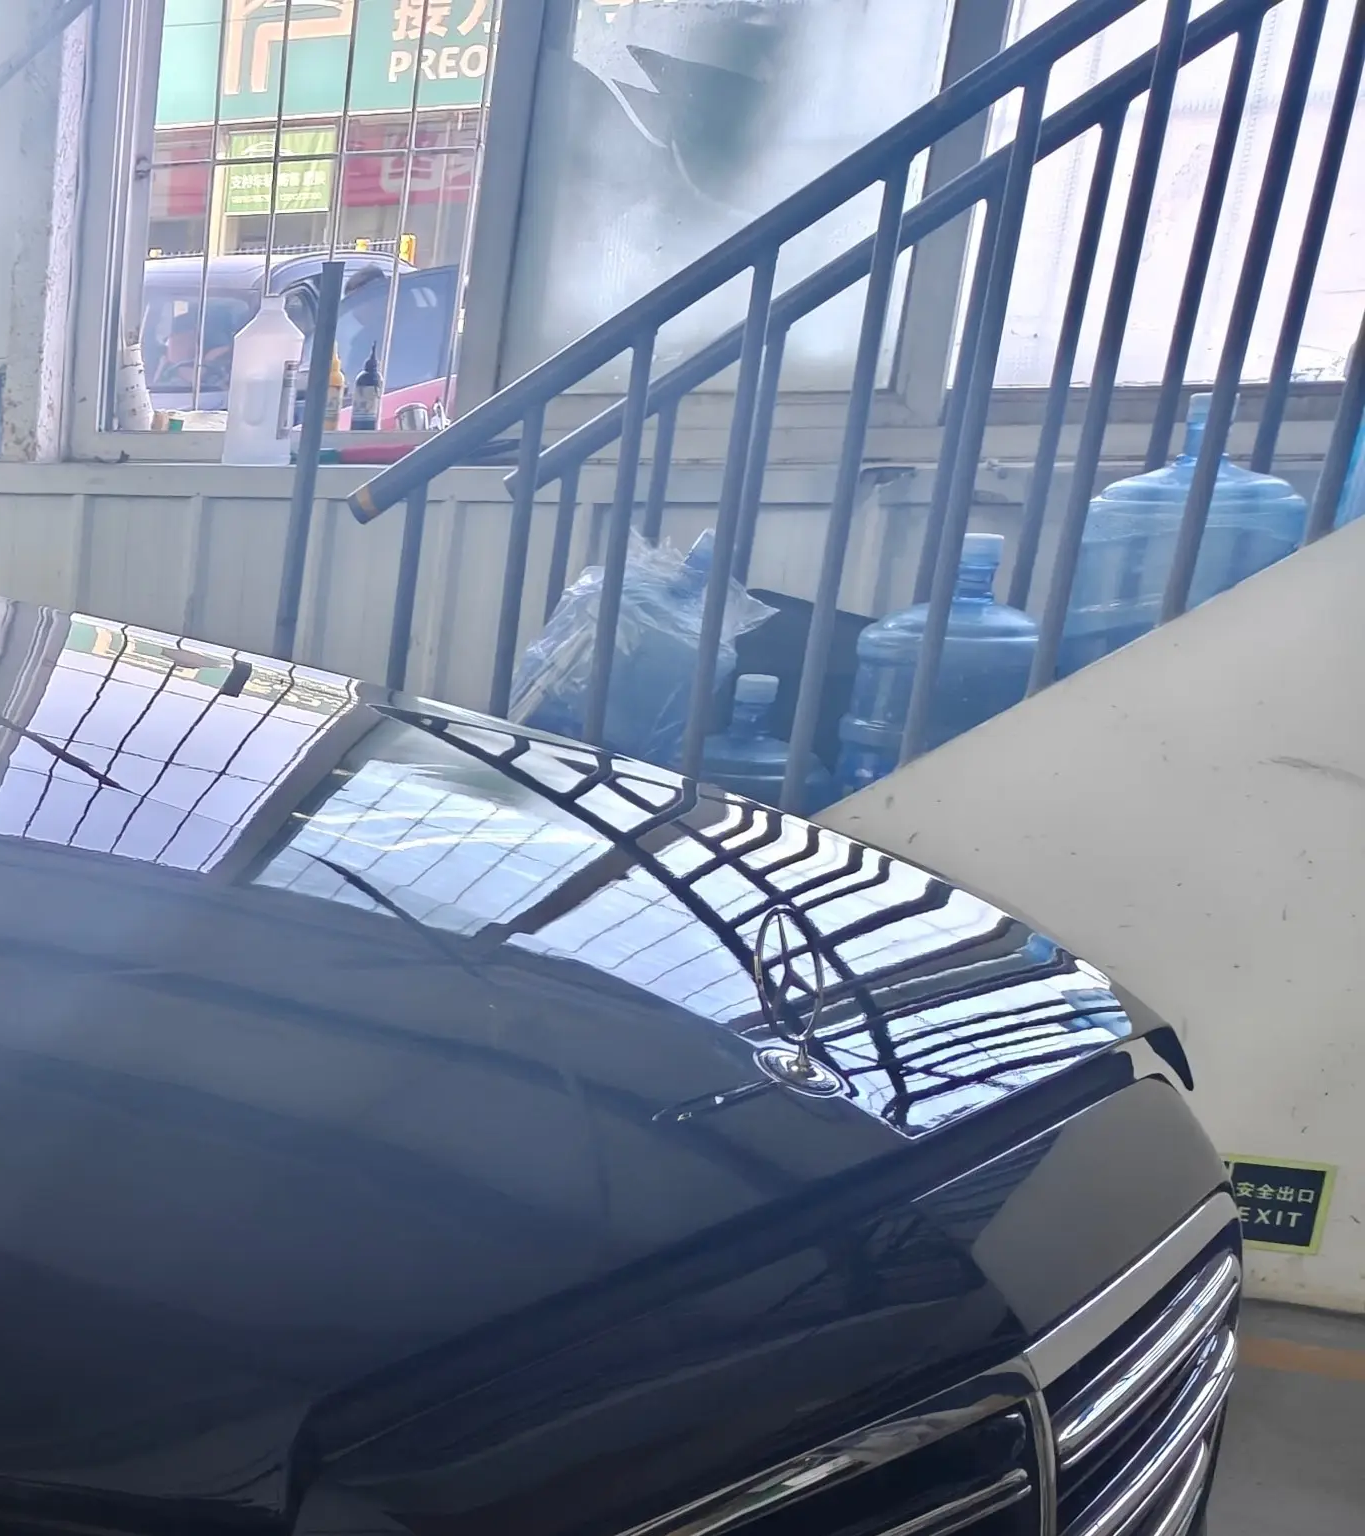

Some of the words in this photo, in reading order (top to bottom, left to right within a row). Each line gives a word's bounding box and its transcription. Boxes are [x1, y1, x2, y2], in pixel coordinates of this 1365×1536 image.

[388, 44, 497, 83] PREO
[1236, 1182, 1315, 1203] 安全出口
[1238, 1206, 1303, 1228] EXIT
